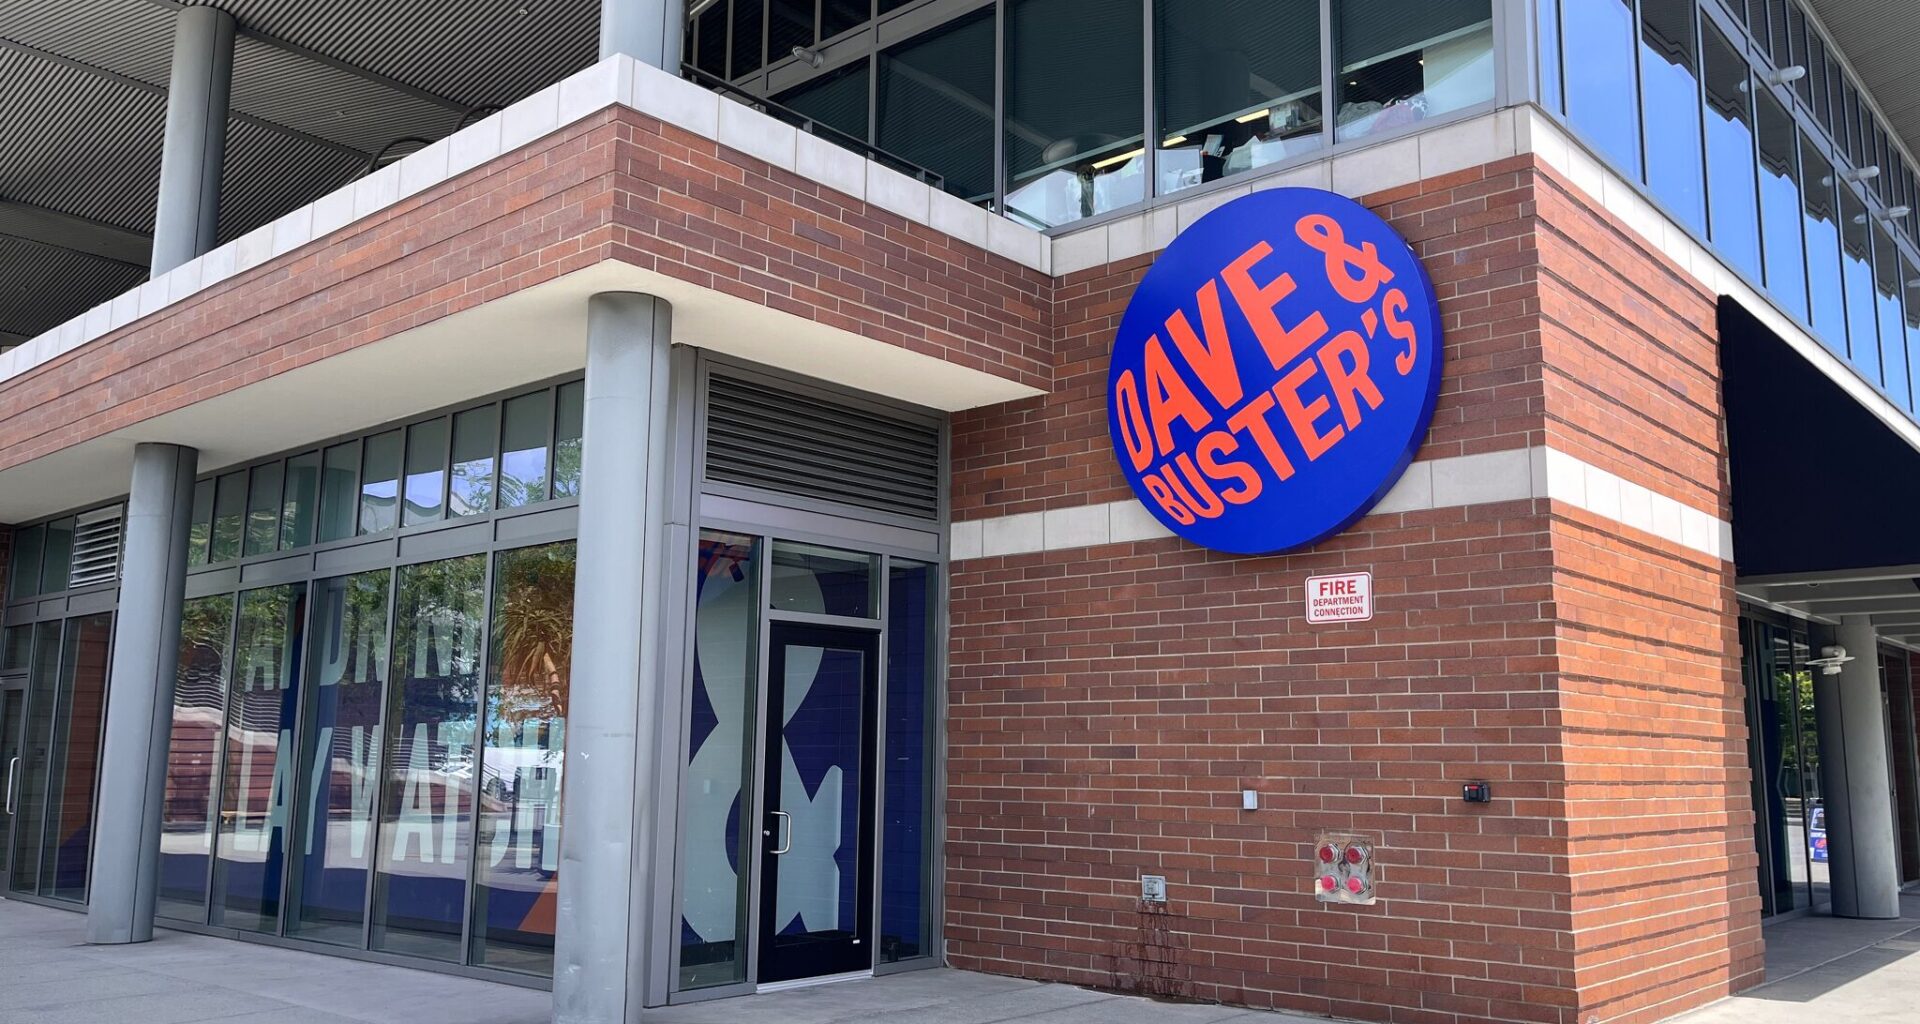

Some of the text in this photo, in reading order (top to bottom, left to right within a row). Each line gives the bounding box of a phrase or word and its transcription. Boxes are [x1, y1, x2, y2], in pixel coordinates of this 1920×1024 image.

[1115, 213, 1395, 473] DAVE &
[1141, 288, 1418, 526] BUSTER'S
[1319, 579, 1357, 596] FIRE
[1312, 595, 1364, 607] DEPARTMENT
[1313, 606, 1364, 617] CONNECTION
